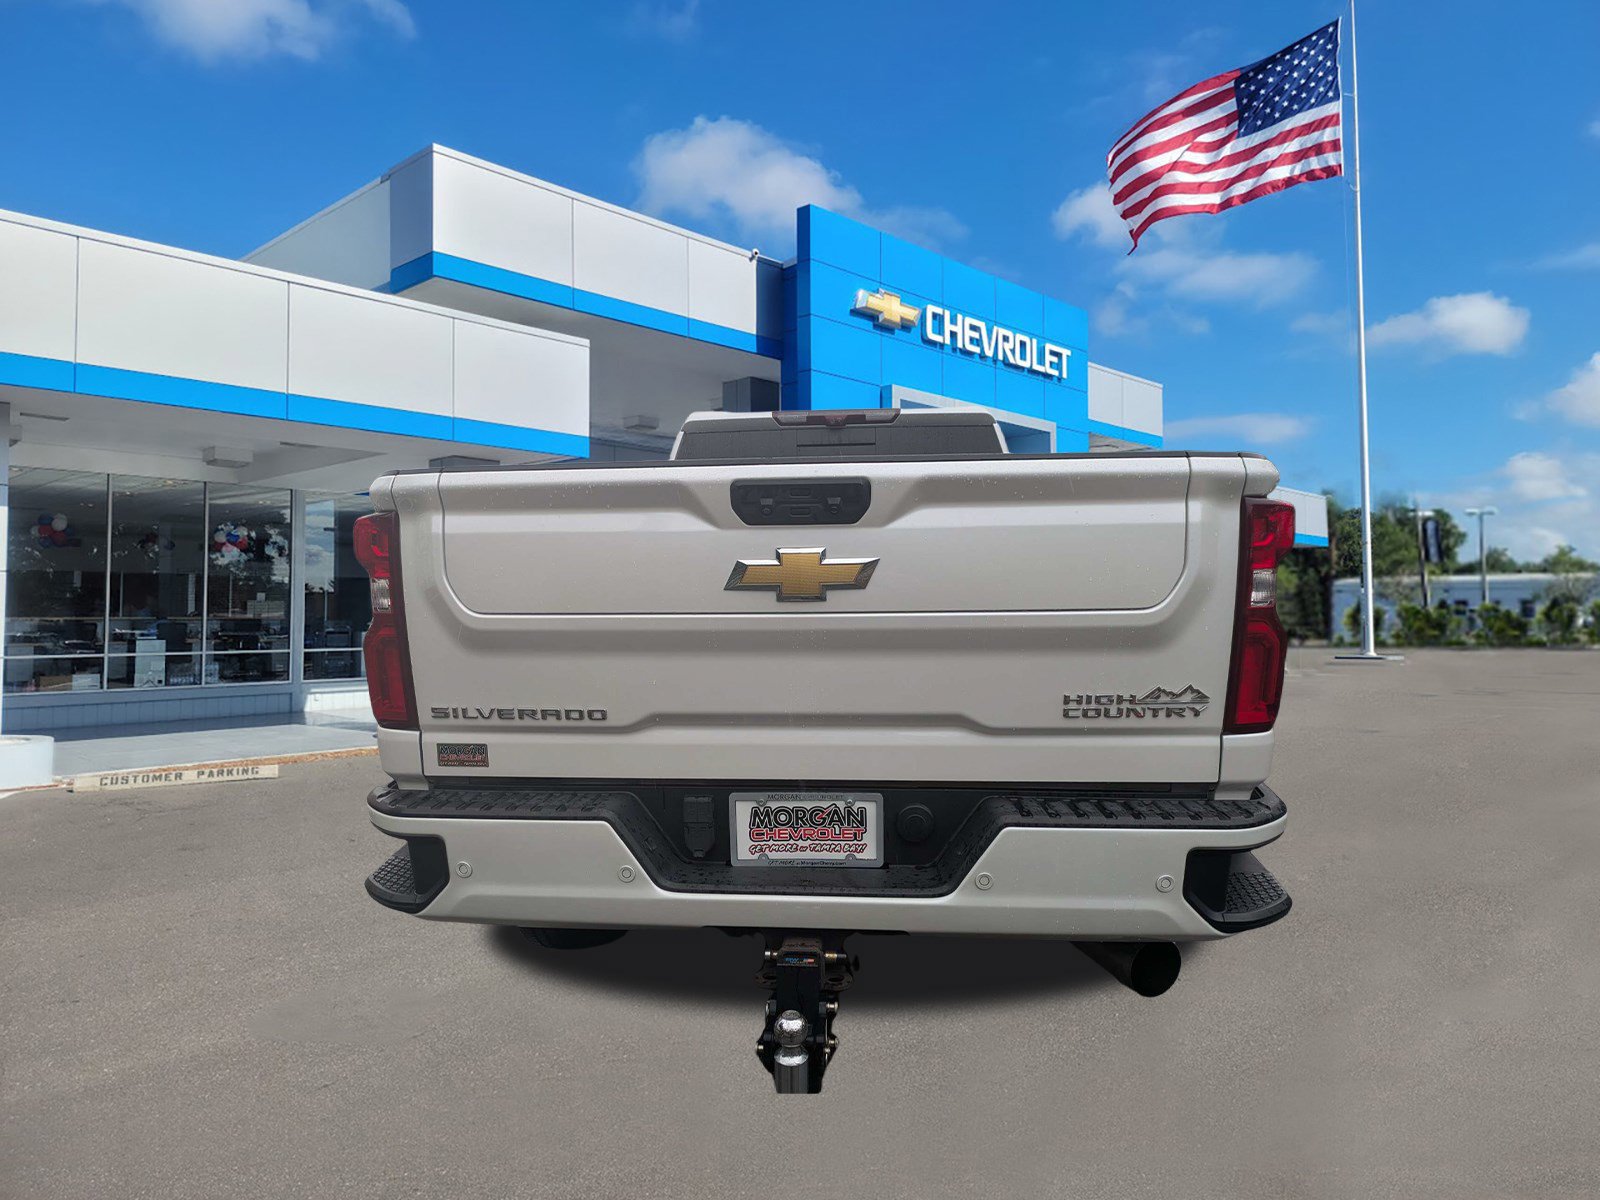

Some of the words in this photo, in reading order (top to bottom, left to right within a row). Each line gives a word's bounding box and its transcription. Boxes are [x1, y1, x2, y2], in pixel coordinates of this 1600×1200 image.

[925, 304, 1072, 379] CHEVROLET
[1063, 694, 1138, 706] HIGH
[431, 706, 608, 721] SILVERADO
[1063, 705, 1208, 719] COUNTRY
[99, 772, 183, 787] CUSTOMER
[197, 766, 260, 779] PARKING
[767, 793, 801, 801] MORGAN
[750, 803, 867, 828] MORGAN
[750, 827, 867, 842] CHEVROLET
[749, 844, 769, 855] GET
[769, 843, 799, 853] MORE
[809, 843, 842, 853] TAMPA
[843, 843, 867, 854] BAY!
